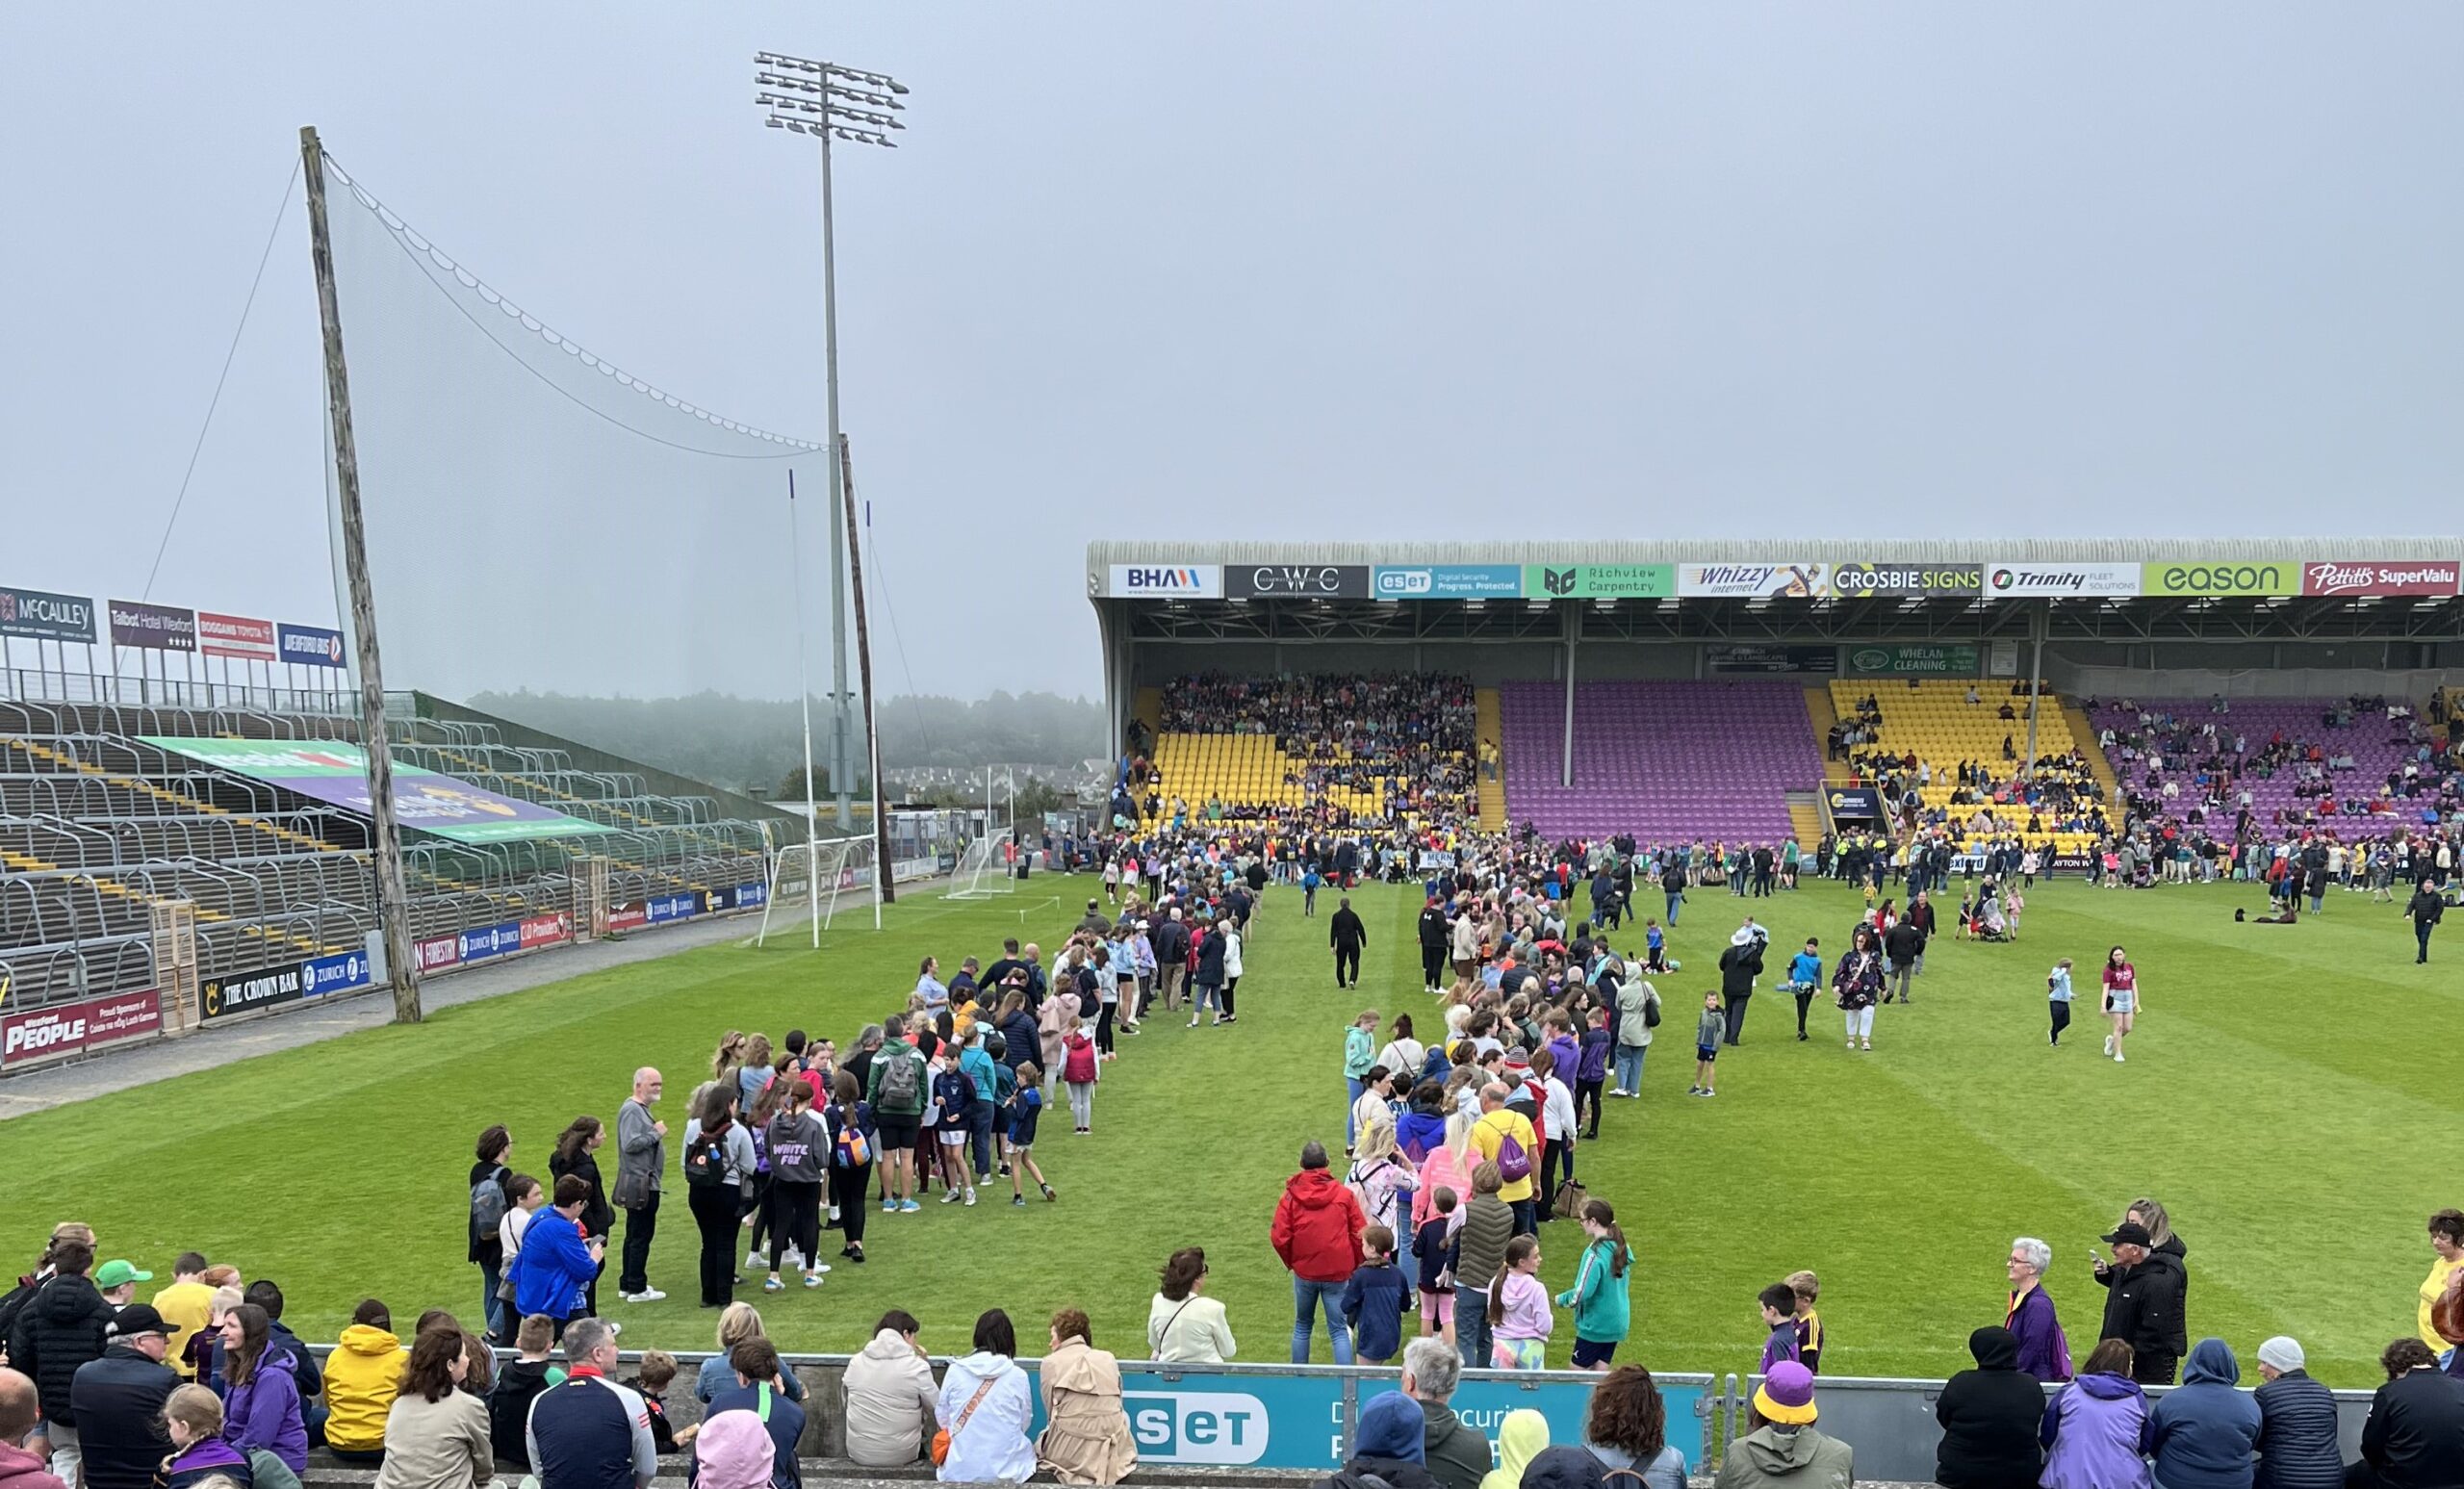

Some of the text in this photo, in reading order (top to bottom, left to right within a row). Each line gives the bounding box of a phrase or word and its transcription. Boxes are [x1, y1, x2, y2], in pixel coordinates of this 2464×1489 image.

[1589, 568, 1656, 578] Richview
[1700, 566, 1776, 591] Whizzy
[1835, 571, 1981, 589] CROSBIE SIGNS
[2165, 566, 2279, 591] eason
[2378, 568, 2454, 587] SuperValu
[1438, 581, 1518, 591] Progress. Protected.
[1589, 581, 1655, 593] Carpentry
[1710, 583, 1754, 594] internet
[2017, 572, 2087, 591] Trinity
[111, 609, 193, 633] Talbot Hotel Wexford
[236, 626, 263, 638] TOYOTA
[317, 638, 330, 655] BUS
[1898, 648, 1944, 659] WHELAN
[1894, 660, 1947, 671] CLEANING
[1427, 853, 1455, 861] MERN
[469, 935, 490, 952] ZURICH
[500, 930, 519, 945] ZURICH
[425, 937, 456, 965] FORESTRY
[317, 965, 346, 983] ZURICH
[224, 971, 299, 1006] THE CROWN BAR
[99, 1006, 116, 1018] Proud
[25, 1014, 60, 1028] Wexford
[6, 1018, 87, 1055] PEOPLE
[773, 1143, 808, 1155] WHITE
[781, 1155, 802, 1166] FOX
